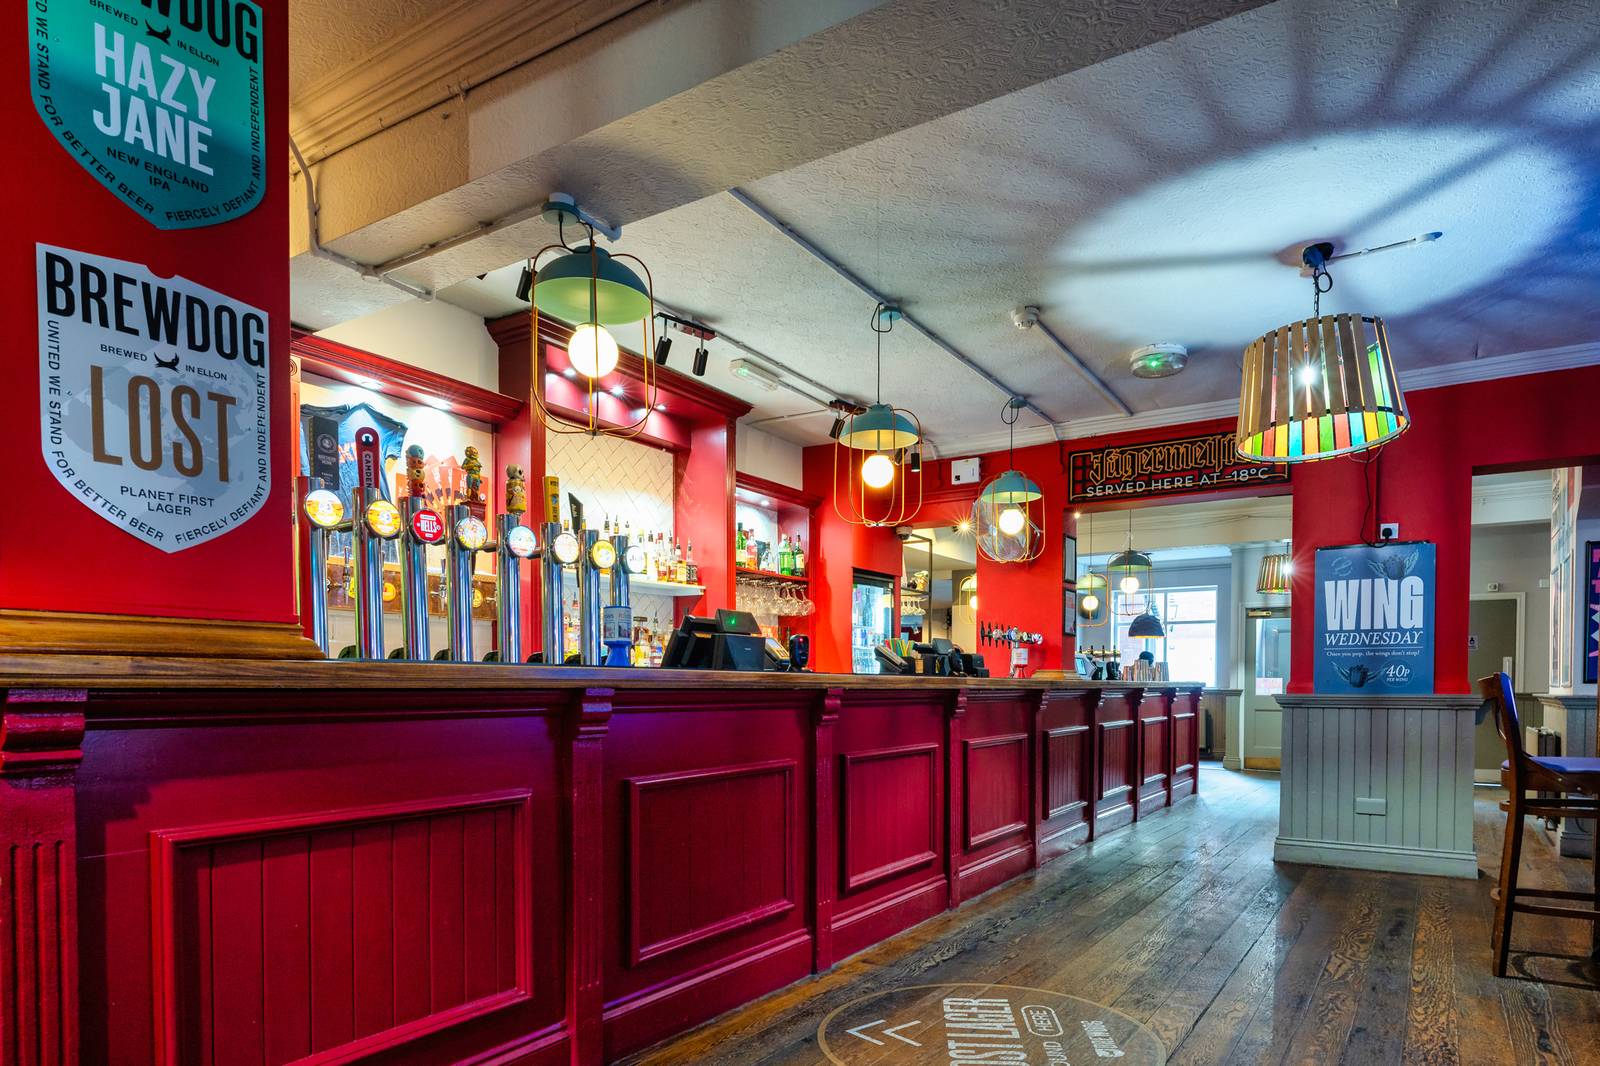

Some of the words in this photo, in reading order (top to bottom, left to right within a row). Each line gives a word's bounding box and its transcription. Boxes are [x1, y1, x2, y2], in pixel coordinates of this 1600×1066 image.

[36, 17, 48, 40] WE
[89, 0, 138, 26] BREWED
[177, 40, 187, 51] IN
[189, 45, 220, 66] ELLON
[37, 42, 50, 90] STAND
[94, 22, 216, 122] HAZY
[39, 95, 64, 127] FOR
[249, 67, 262, 156] INDEPENDENT
[93, 82, 214, 176] JANE
[62, 130, 117, 184] BETTER
[106, 147, 140, 167] NEW
[144, 162, 209, 193] ENGLAND
[252, 157, 261, 181] AND
[117, 180, 155, 214] BEER
[149, 177, 171, 192] IPA
[223, 183, 259, 212] DEFIANT
[165, 206, 222, 222] FIERCELY
[45, 251, 265, 369] BREWDOG
[47, 320, 60, 371] UNITED
[100, 343, 148, 362] BREWED
[185, 364, 196, 374] IN
[197, 367, 228, 381] ELLON
[48, 375, 61, 396] WE
[49, 400, 63, 446] STAND
[90, 364, 237, 483] LOST
[256, 373, 267, 456] INDEPENDENT
[51, 450, 76, 479] FOR
[257, 459, 267, 482] AND
[74, 479, 127, 521] BETTER
[120, 486, 174, 503] PLANET
[178, 494, 215, 508] FIRST
[1087, 481, 1146, 498] SERVED
[1152, 475, 1194, 491] HERE
[1200, 473, 1222, 486] AT
[147, 501, 192, 517] LAGER
[230, 486, 266, 522] DEFIANT
[128, 517, 165, 542] BEER
[175, 518, 229, 544] FIERCELY
[1324, 576, 1424, 631] WING
[1325, 631, 1424, 646] WEDNESDAY
[943, 997, 1020, 1039] LAGER
[1029, 1009, 1054, 1032] HERE
